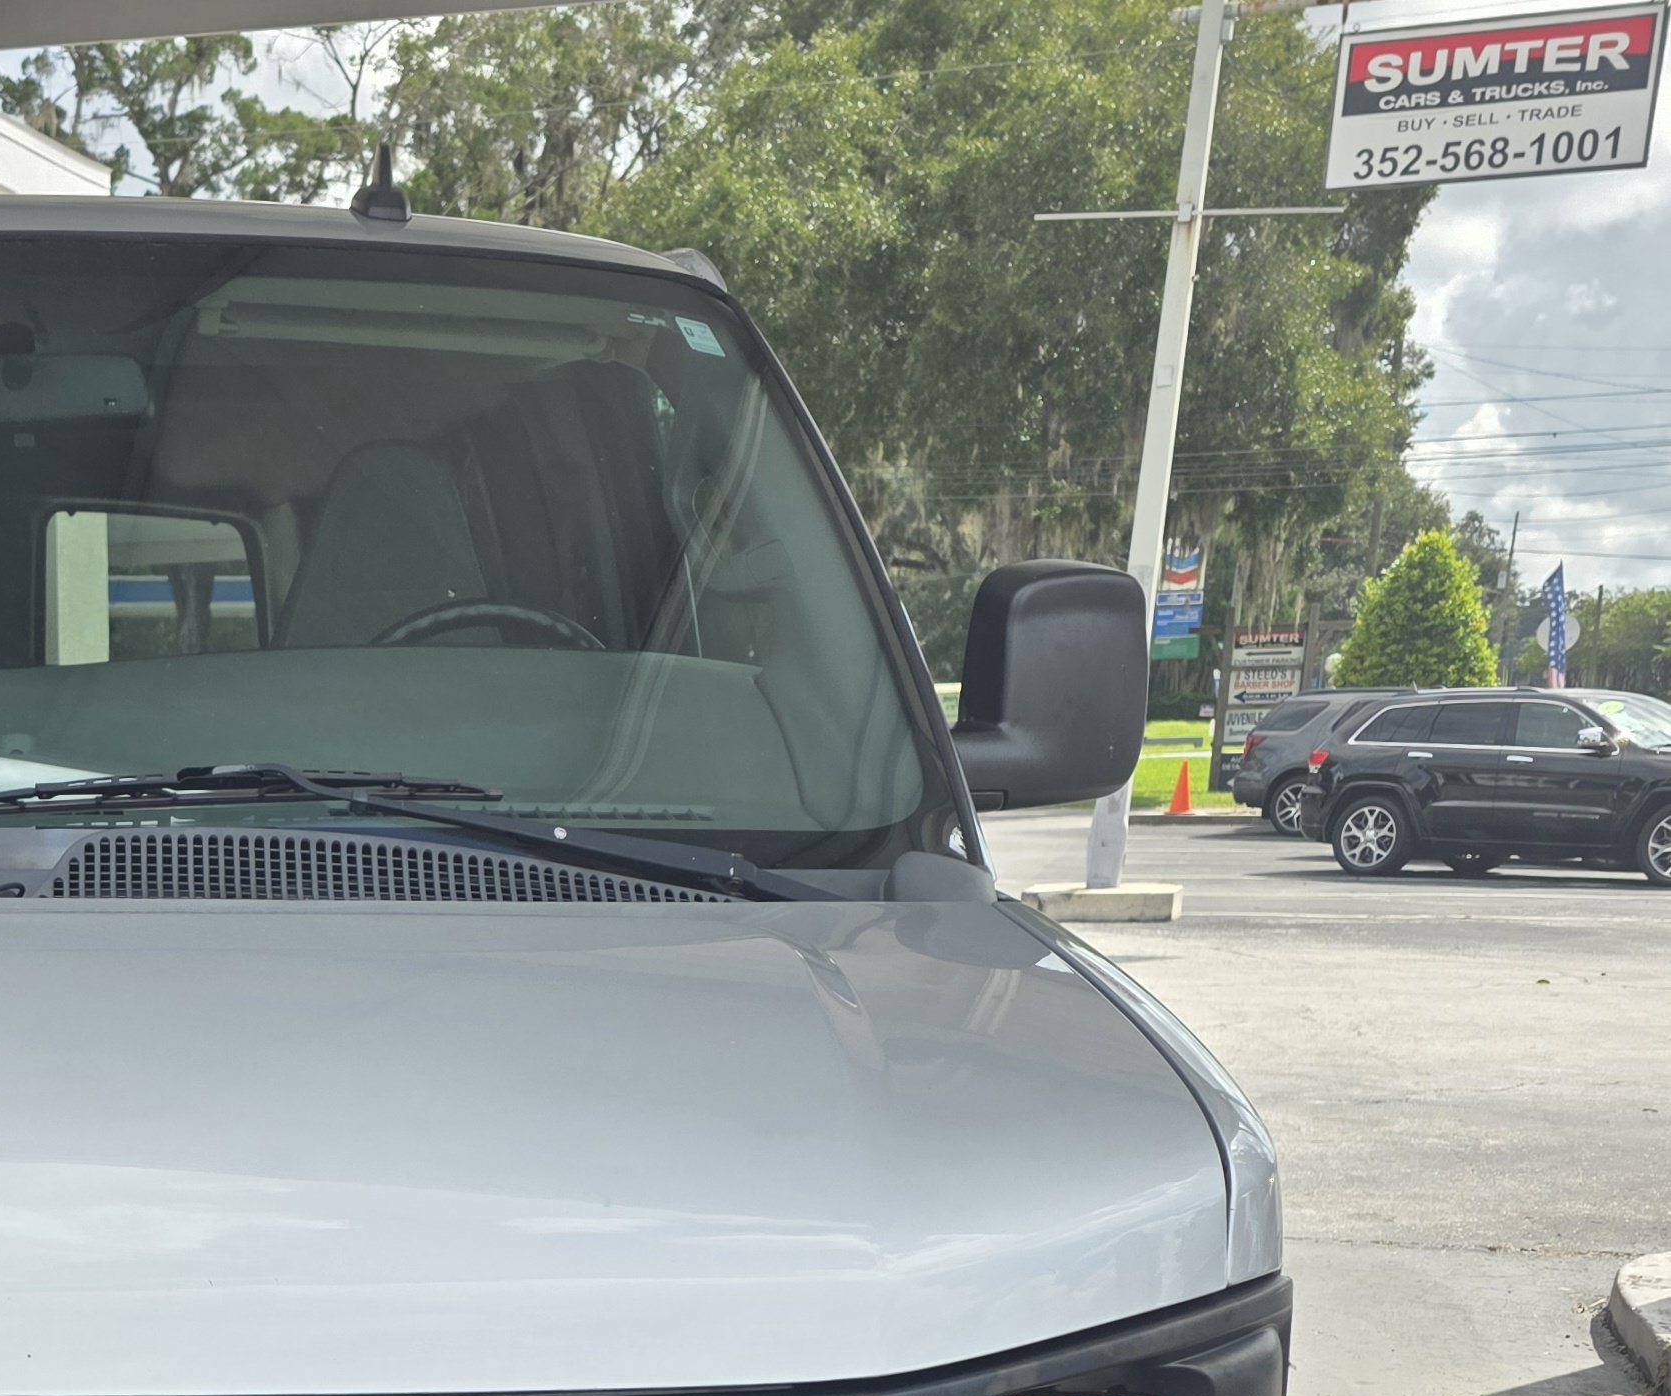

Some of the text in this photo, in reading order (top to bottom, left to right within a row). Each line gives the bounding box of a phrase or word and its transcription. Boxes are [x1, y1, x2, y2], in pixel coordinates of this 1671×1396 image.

[1364, 31, 1631, 93] SUMTER
[1378, 79, 1610, 111] CARS & TRUCKS, Inc.
[1397, 104, 1584, 133] BUY SELL TRADE
[1352, 125, 1624, 181] 352-568-1001
[1238, 632, 1300, 645] SUMTER
[1233, 680, 1296, 690] BARBER SHOP
